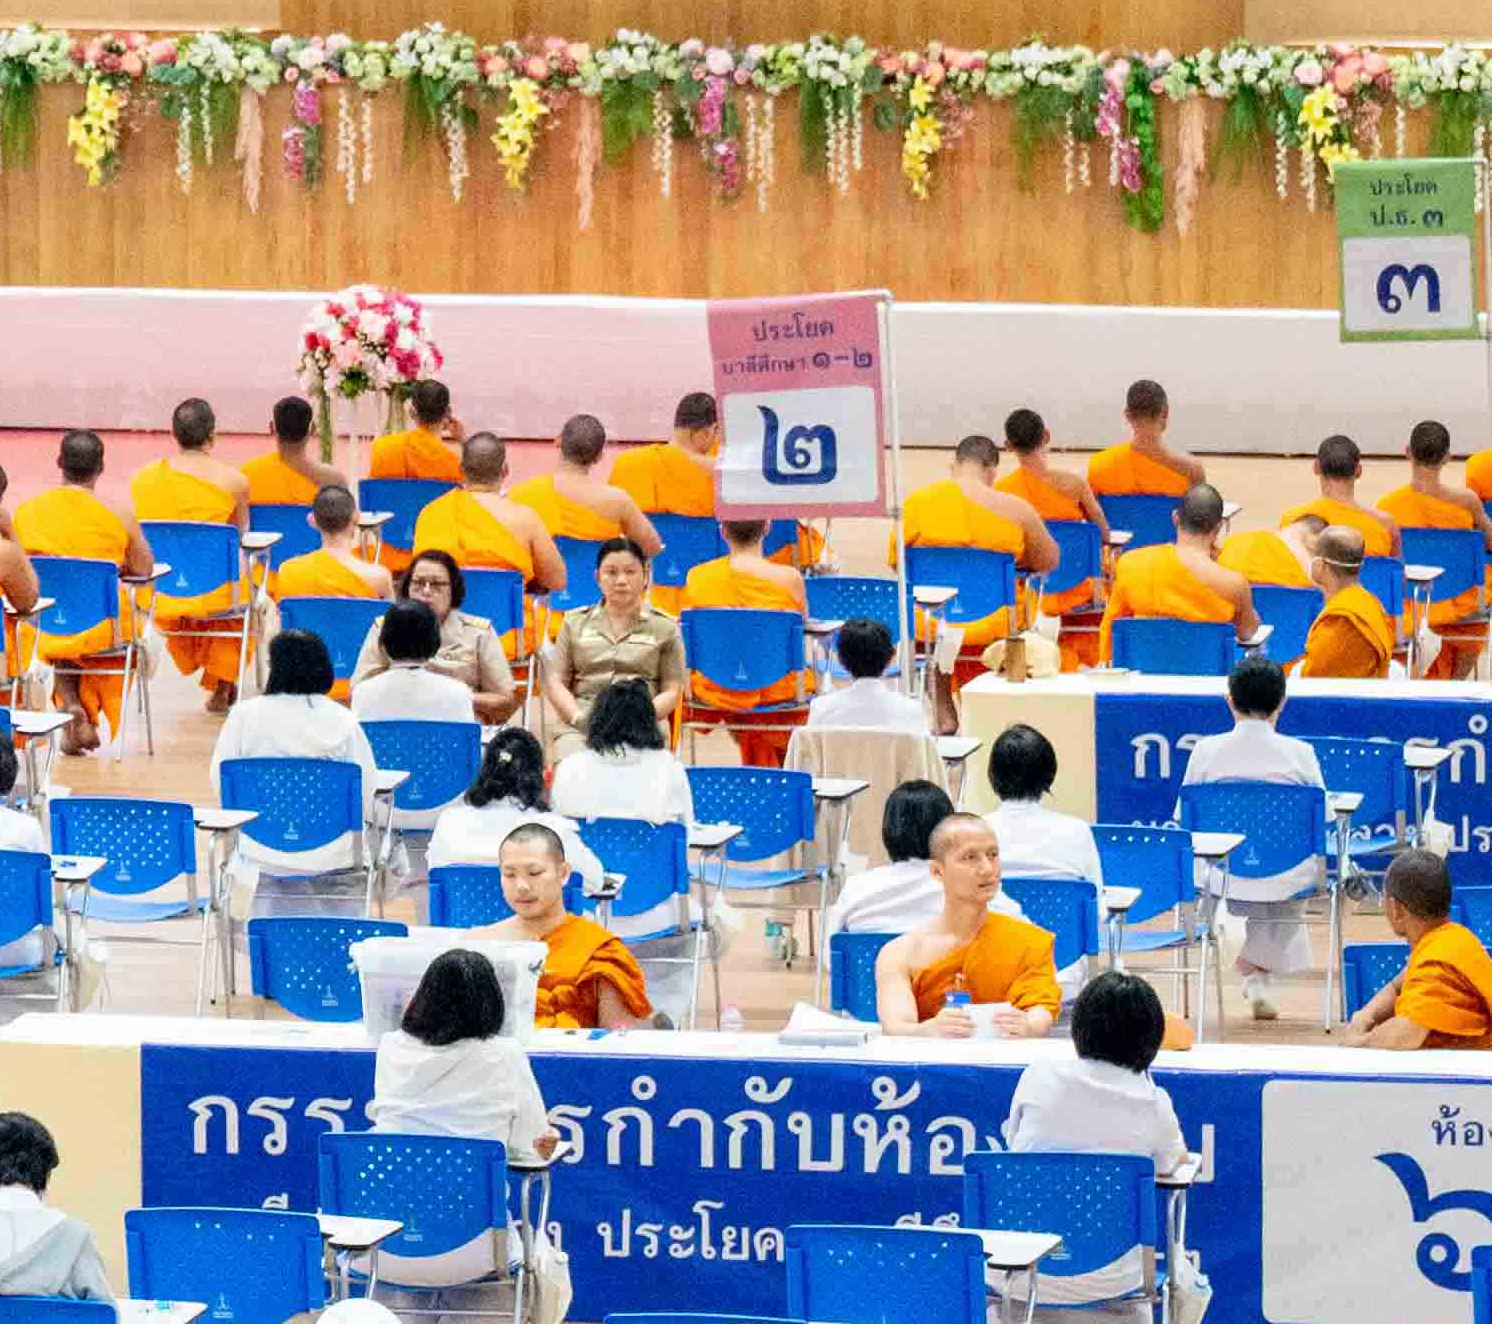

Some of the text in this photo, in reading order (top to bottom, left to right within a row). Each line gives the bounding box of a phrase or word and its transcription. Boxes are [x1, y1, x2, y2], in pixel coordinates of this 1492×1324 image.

[1369, 173, 1437, 197] ประโยค
[1377, 263, 1441, 314] ๓
[753, 311, 834, 341] ประโยค
[756, 405, 838, 486] ๒
[1431, 1104, 1492, 1146] ห้อ
[597, 1199, 786, 1263] ประโยค
